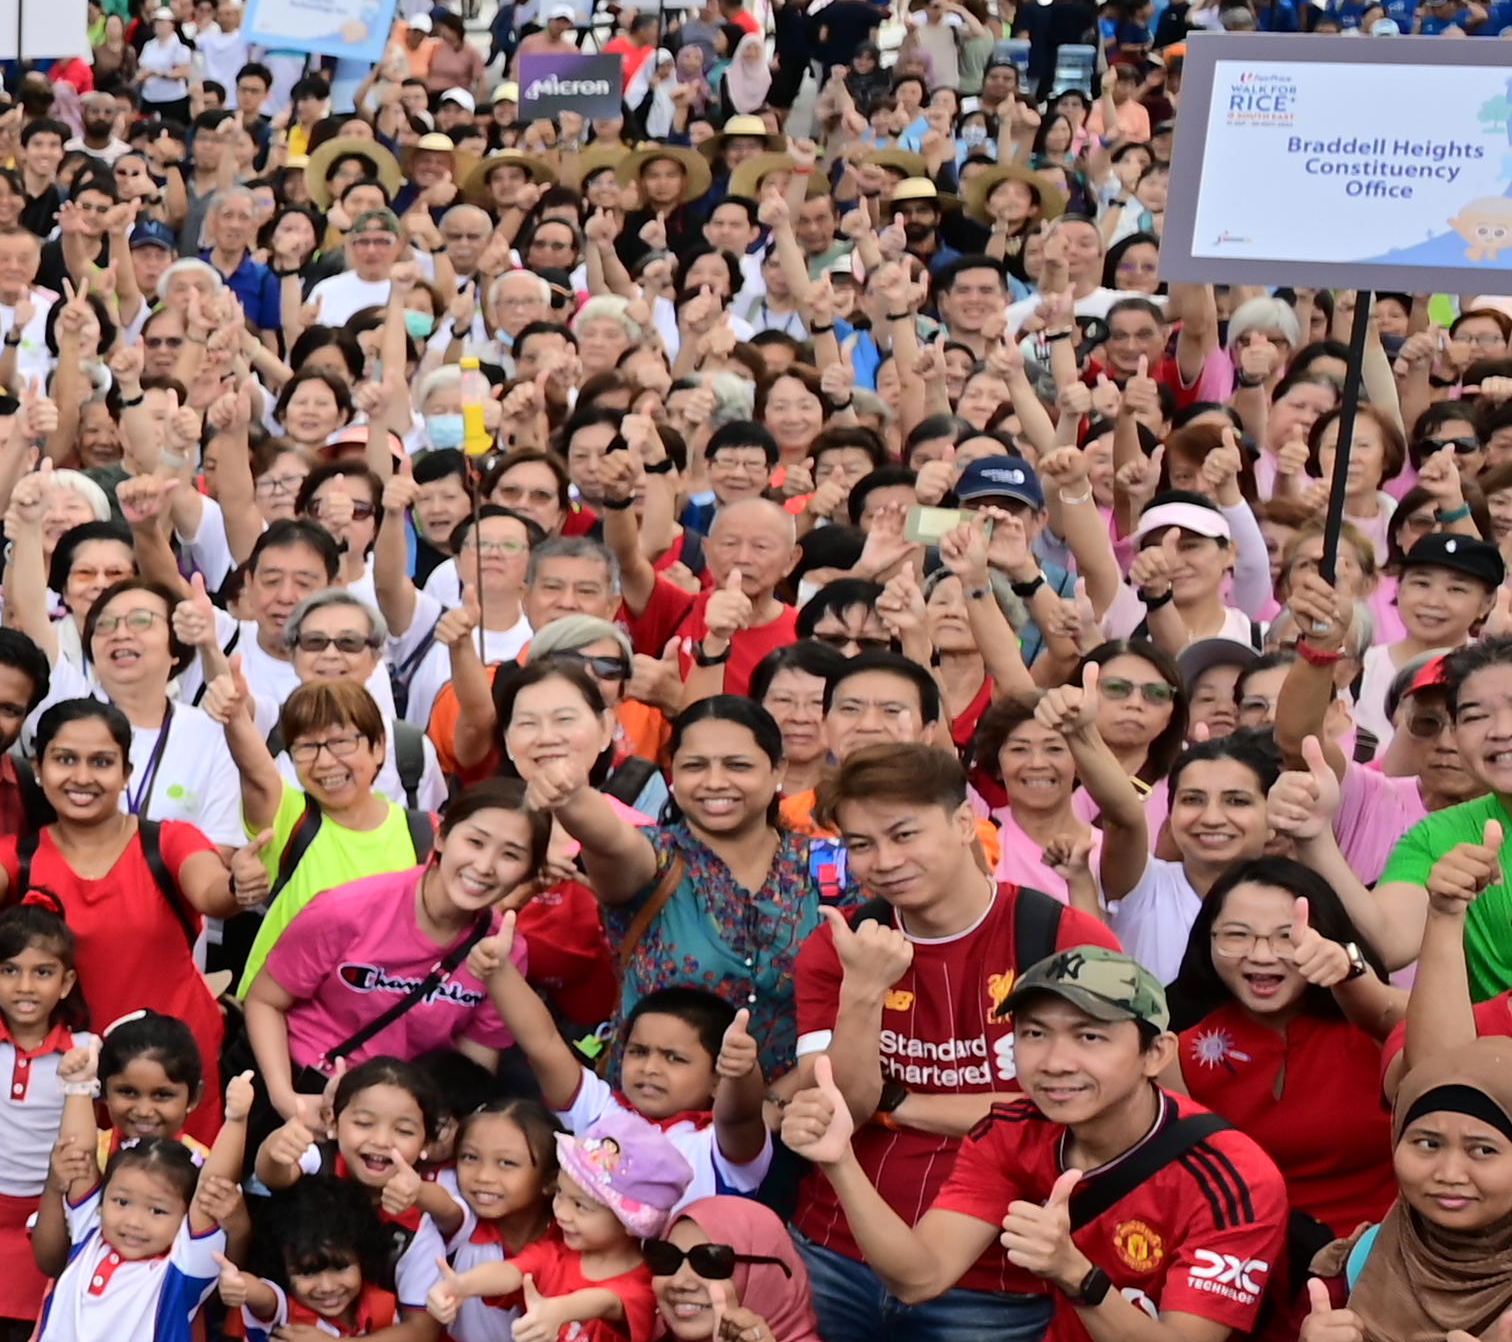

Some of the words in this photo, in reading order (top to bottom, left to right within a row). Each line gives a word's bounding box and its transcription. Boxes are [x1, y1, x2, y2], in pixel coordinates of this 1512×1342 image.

[524, 72, 610, 100] Micron
[1287, 135, 1386, 156] Braddell
[1392, 138, 1485, 162] Heights
[1304, 158, 1462, 183] Constituency
[1345, 179, 1414, 200] Office
[879, 1030, 988, 1062] Standard
